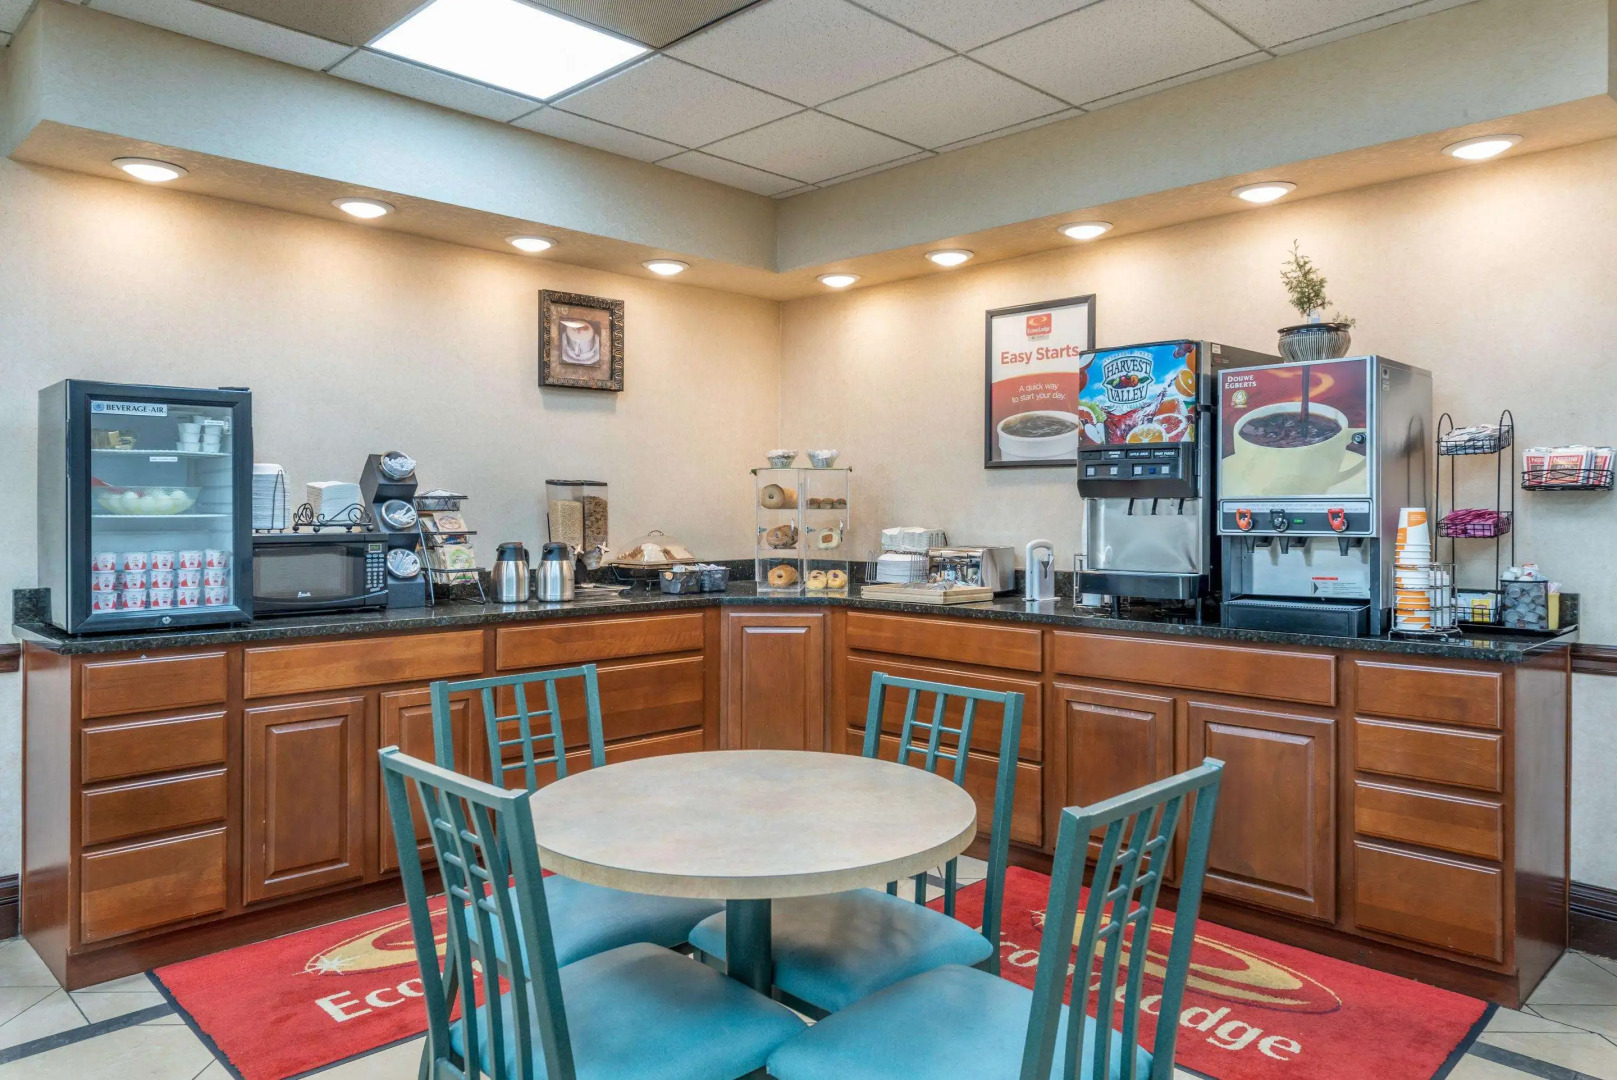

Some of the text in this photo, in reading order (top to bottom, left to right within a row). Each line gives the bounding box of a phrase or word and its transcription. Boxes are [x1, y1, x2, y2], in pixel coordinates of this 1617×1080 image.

[1001, 344, 1079, 365] Easy Starts
[1106, 359, 1151, 379] HARVEST
[1026, 383, 1043, 392] quick
[1044, 383, 1059, 391] way
[1225, 381, 1257, 389] EGBERTS
[1019, 393, 1035, 402] start
[1036, 392, 1051, 401] your
[1109, 385, 1145, 402] VALLEY
